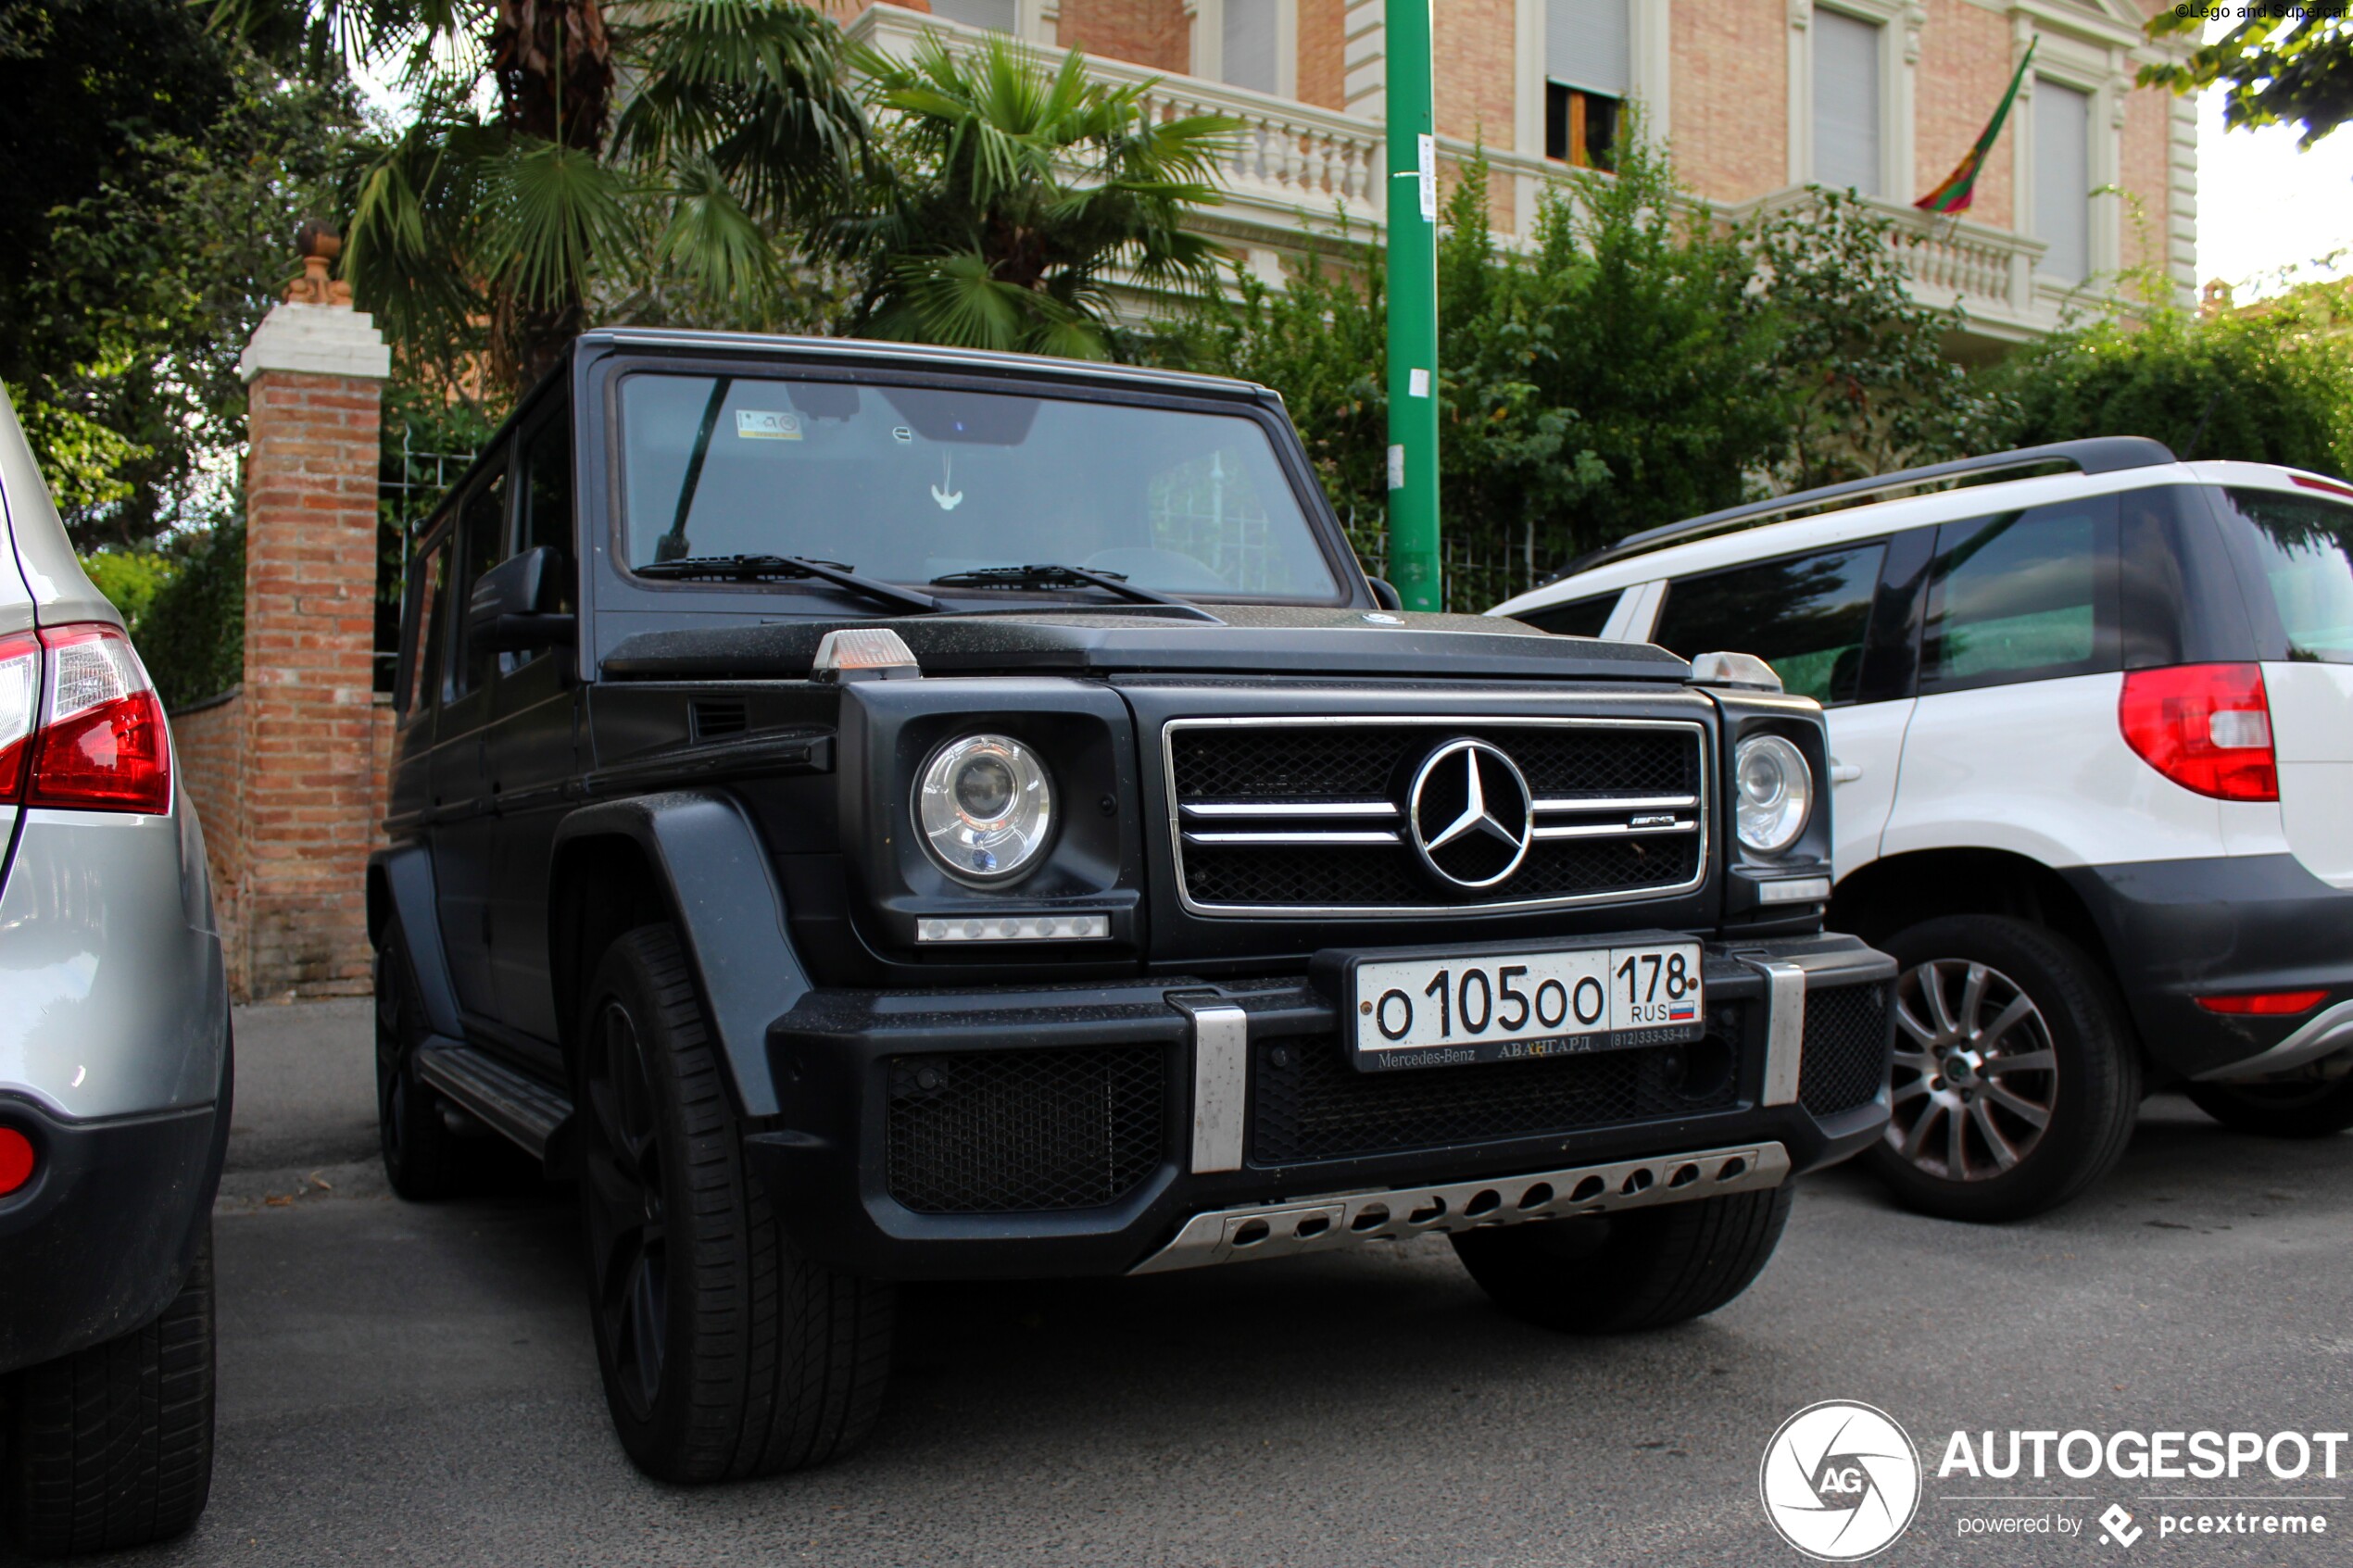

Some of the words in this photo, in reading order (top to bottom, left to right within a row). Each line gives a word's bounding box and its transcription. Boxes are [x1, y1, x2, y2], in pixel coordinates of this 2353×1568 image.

[1617, 952, 1686, 1004] 178
[1631, 1004, 1667, 1023] RUS
[1611, 1027, 1691, 1047] (812)333-33-44
[1378, 1048, 1476, 1069] Mercedes-Benz
